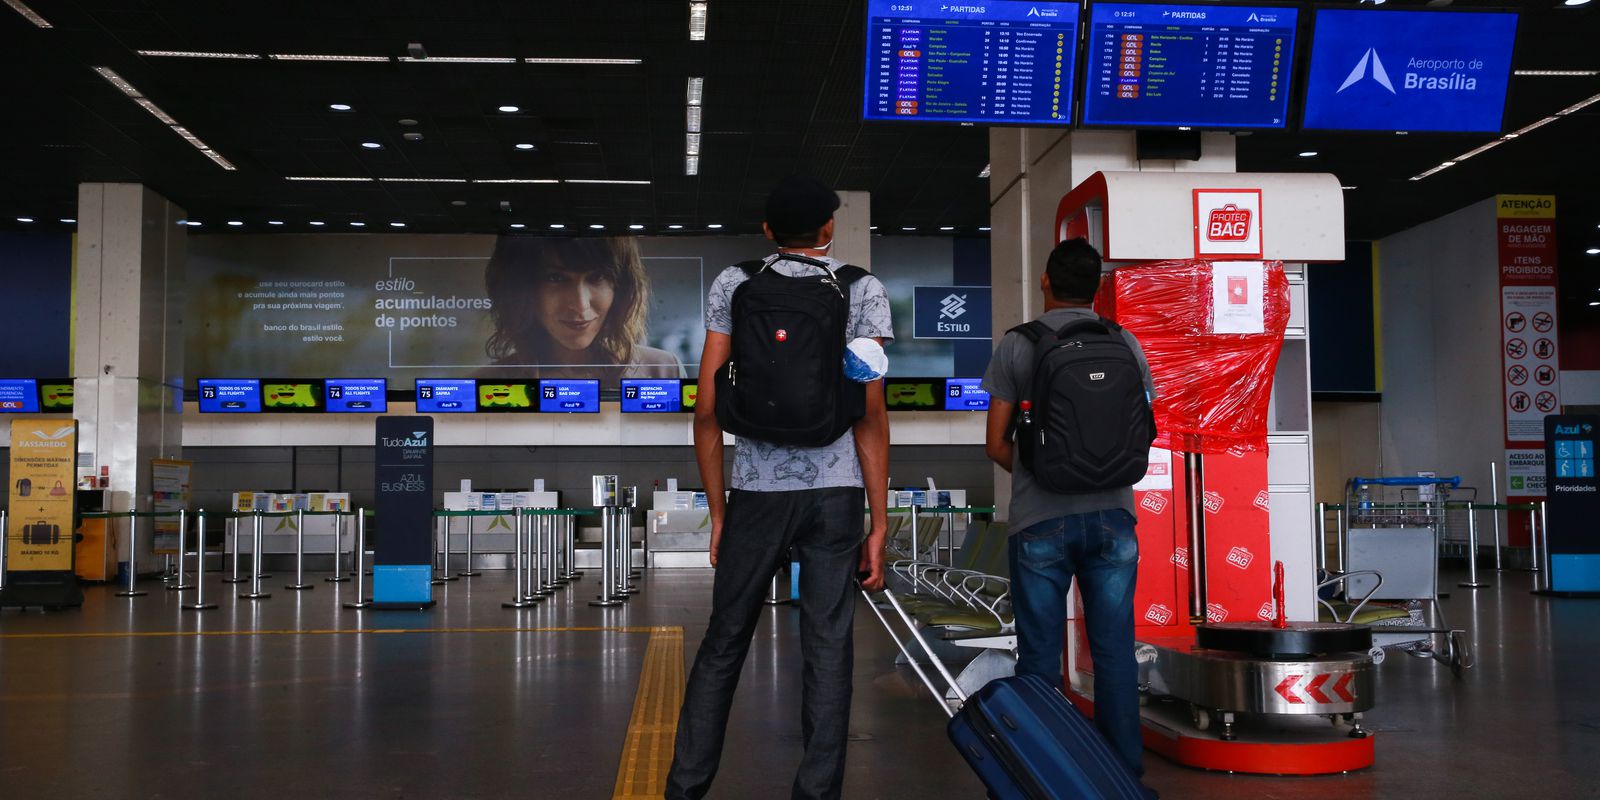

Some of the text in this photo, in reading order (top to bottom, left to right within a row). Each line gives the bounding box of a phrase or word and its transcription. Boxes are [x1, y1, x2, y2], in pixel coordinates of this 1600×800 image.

[1407, 57, 1483, 71] Aeroporto de
[1404, 72, 1477, 90] Brasília
[1501, 198, 1552, 210] ATENÇÃO
[1212, 213, 1247, 221] PROTEC
[1210, 222, 1246, 237] BAG
[1503, 224, 1551, 234] BAGAGEM
[1508, 233, 1546, 243] DE MÃO
[324, 280, 345, 288] estilo
[318, 291, 345, 299] pontos
[375, 295, 492, 309] acumuladores
[375, 313, 457, 331] de pontos
[1554, 424, 1580, 434] Azul
[381, 436, 427, 447] TudoAzul
[400, 473, 425, 483] AZUL
[381, 482, 426, 492] BUSINESS
[1142, 497, 1162, 511] BAG
[1228, 552, 1248, 567] BAG
[1147, 609, 1167, 624] BAG
